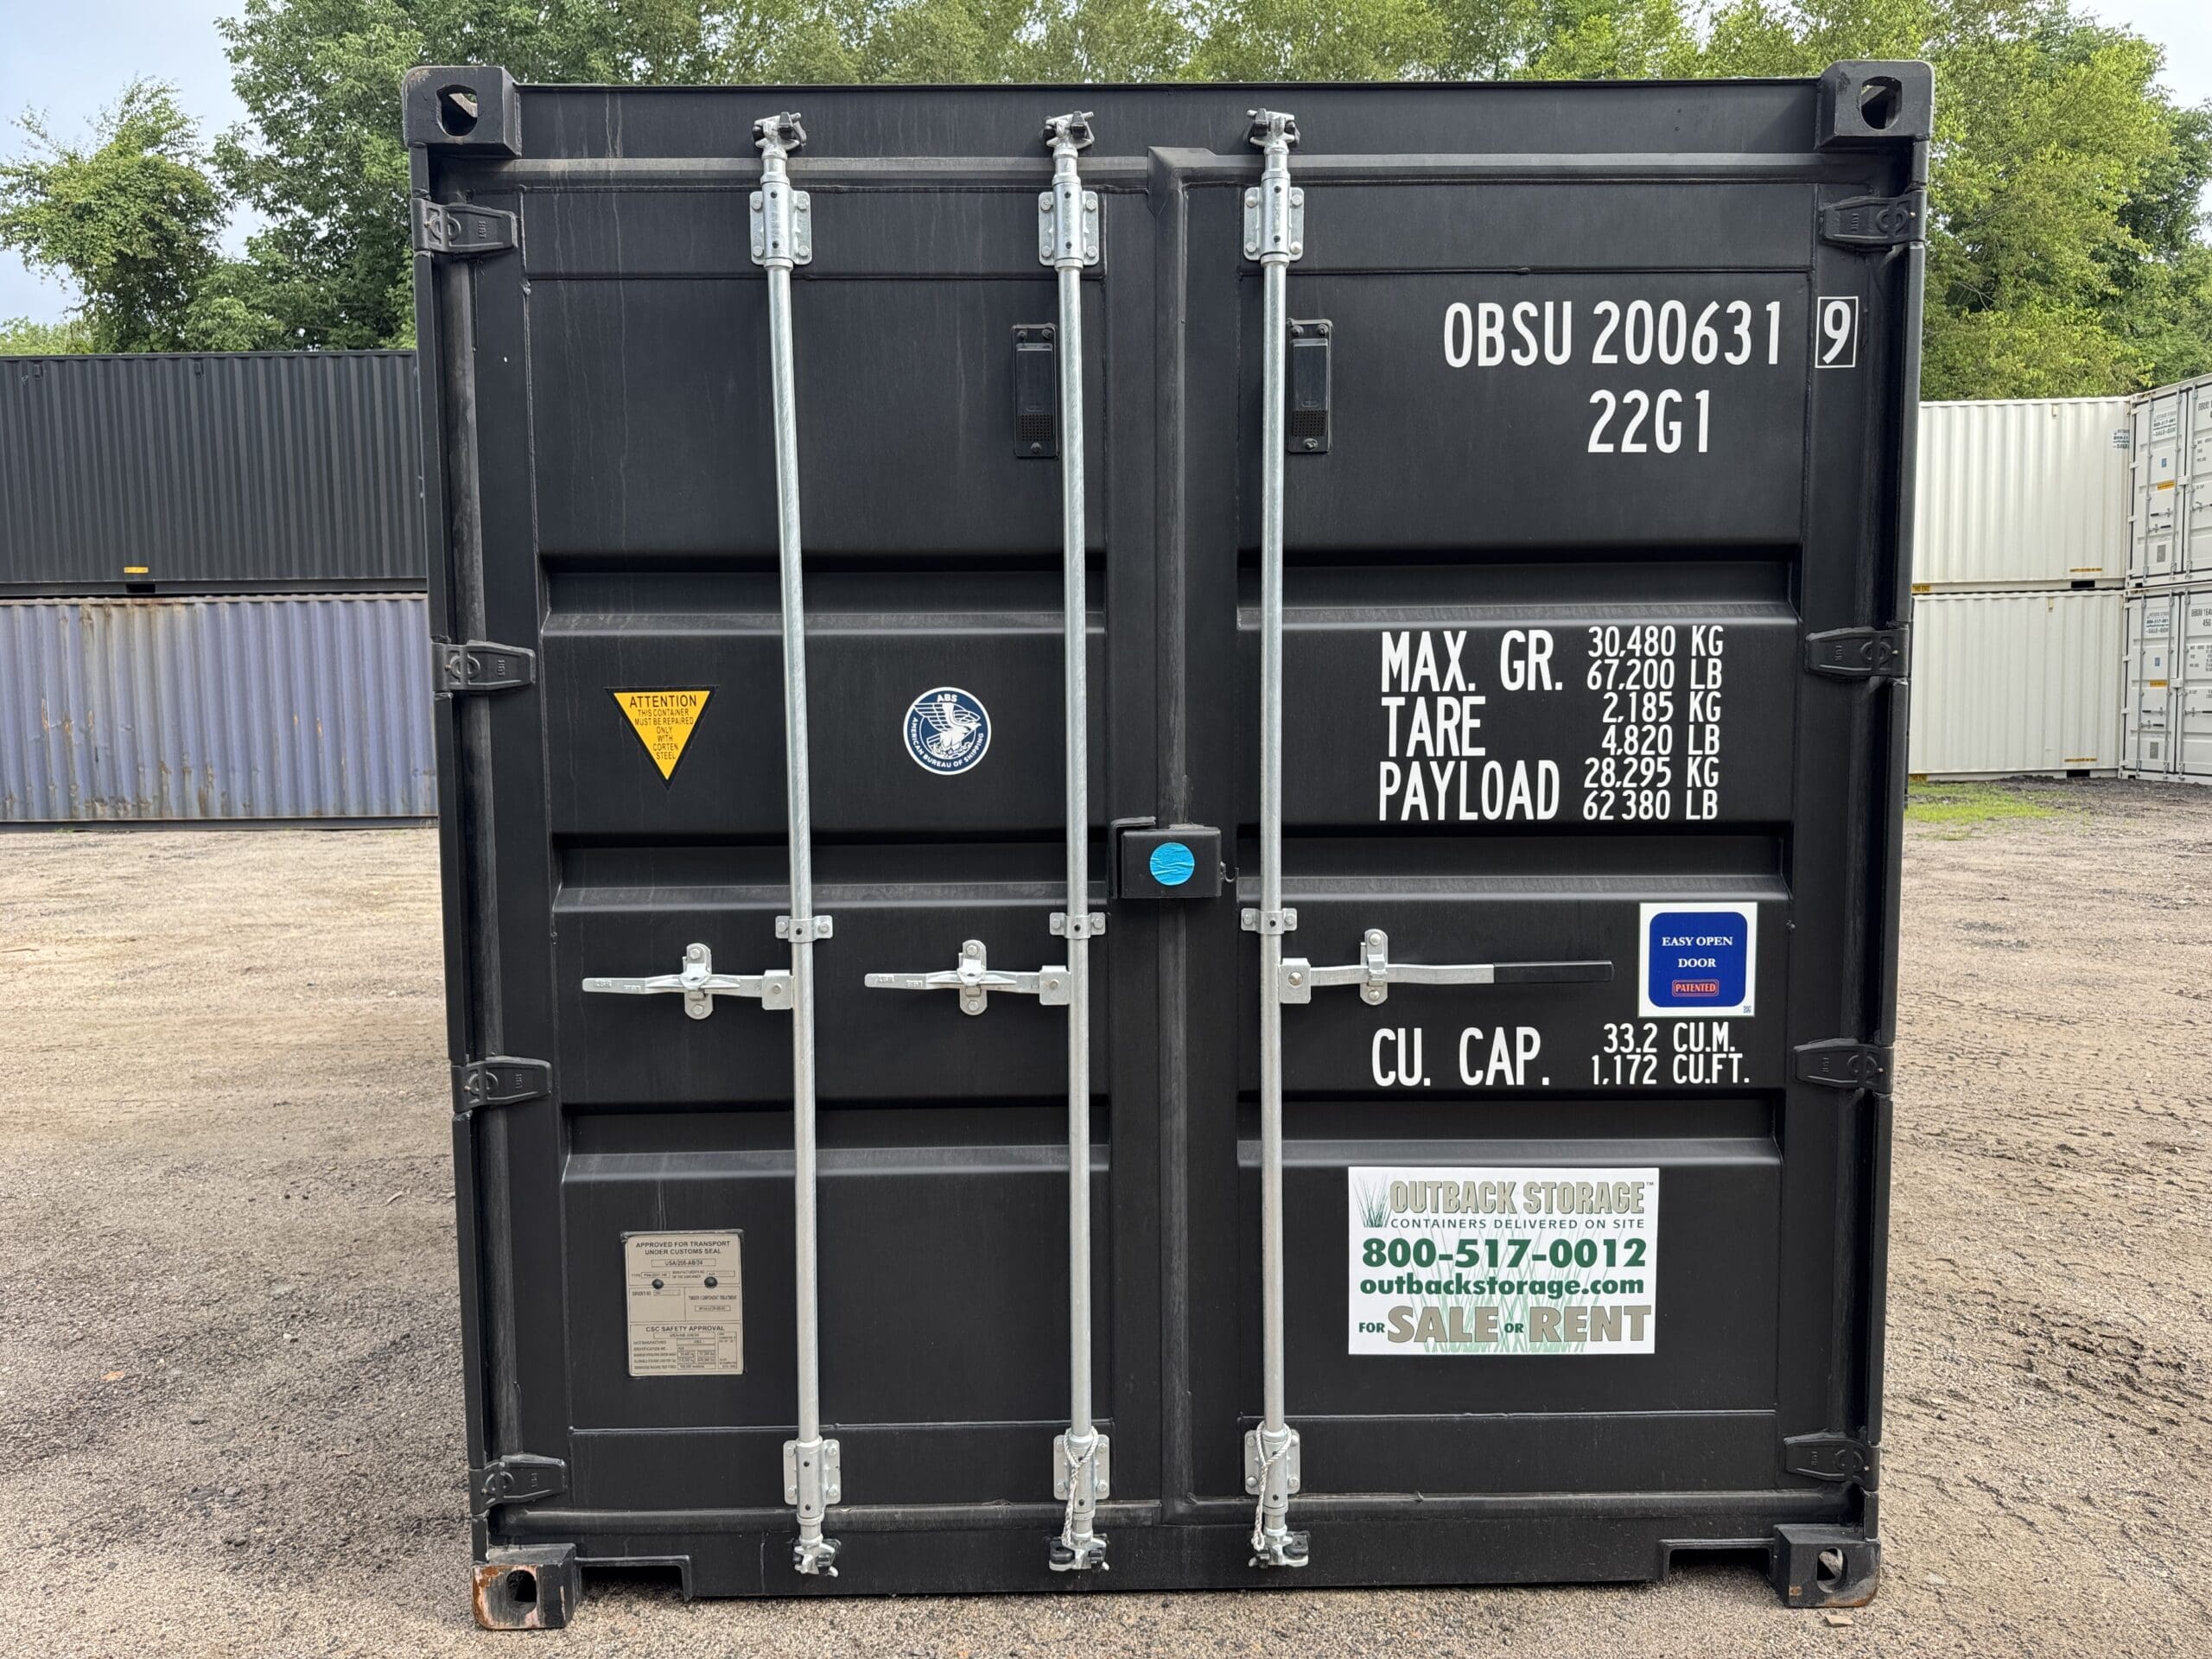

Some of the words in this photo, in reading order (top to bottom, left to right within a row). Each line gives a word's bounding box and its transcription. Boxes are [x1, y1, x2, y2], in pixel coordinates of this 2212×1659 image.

[1444, 301, 1572, 367] OBSU
[1592, 300, 1781, 365] 200631
[1822, 300, 1851, 365] 9
[1588, 389, 1710, 454] 22G1
[1381, 630, 1477, 692] MAX.
[1499, 630, 1563, 691] GR.
[1587, 625, 1676, 658] 30,480
[1691, 625, 1724, 657] KG
[1586, 658, 1675, 690] 67,200
[1690, 658, 1722, 690] LB
[629, 695, 697, 708] ATTENTION
[937, 694, 957, 702] ABS
[1381, 696, 1486, 758] TARE
[1602, 691, 1674, 723] 2,185
[1689, 690, 1722, 722] KG
[1601, 724, 1673, 756] 4,820
[1688, 724, 1720, 755] LB
[923, 754, 951, 767] BUREAU
[963, 732, 984, 762] SHIPPING
[1378, 760, 1559, 822] PAYLOAD
[1584, 756, 1672, 788] 28,295
[1687, 756, 1719, 788] KG
[1686, 789, 1718, 820] LB
[1662, 937, 1694, 946] EASY
[1696, 936, 1733, 946] OPEN
[1677, 958, 1717, 968] DOOR
[1675, 983, 1717, 992] PATENTED
[1371, 1027, 1431, 1086] CU.
[1459, 1027, 1550, 1086] CAP.
[1603, 1022, 1658, 1053] 33.2
[1673, 1021, 1735, 1052] CU.M.
[1591, 1054, 1657, 1085] 1,172
[1672, 1052, 1750, 1084] CU.FT.
[1389, 1180, 1518, 1215] OUTBACK
[1522, 1180, 1645, 1215] STORAGE
[1390, 1218, 1487, 1229] CONTAINERS
[1494, 1218, 1578, 1229] DELIVERED
[1585, 1218, 1605, 1229] ON
[1612, 1218, 1644, 1229] SITE
[1362, 1237, 1647, 1268] 800-517-0012
[1359, 1272, 1644, 1300] outbackstorage.com
[1358, 1322, 1386, 1333] FOR
[1387, 1306, 1499, 1344] SALE
[1503, 1322, 1524, 1333] OR
[1529, 1305, 1652, 1343] RENT
